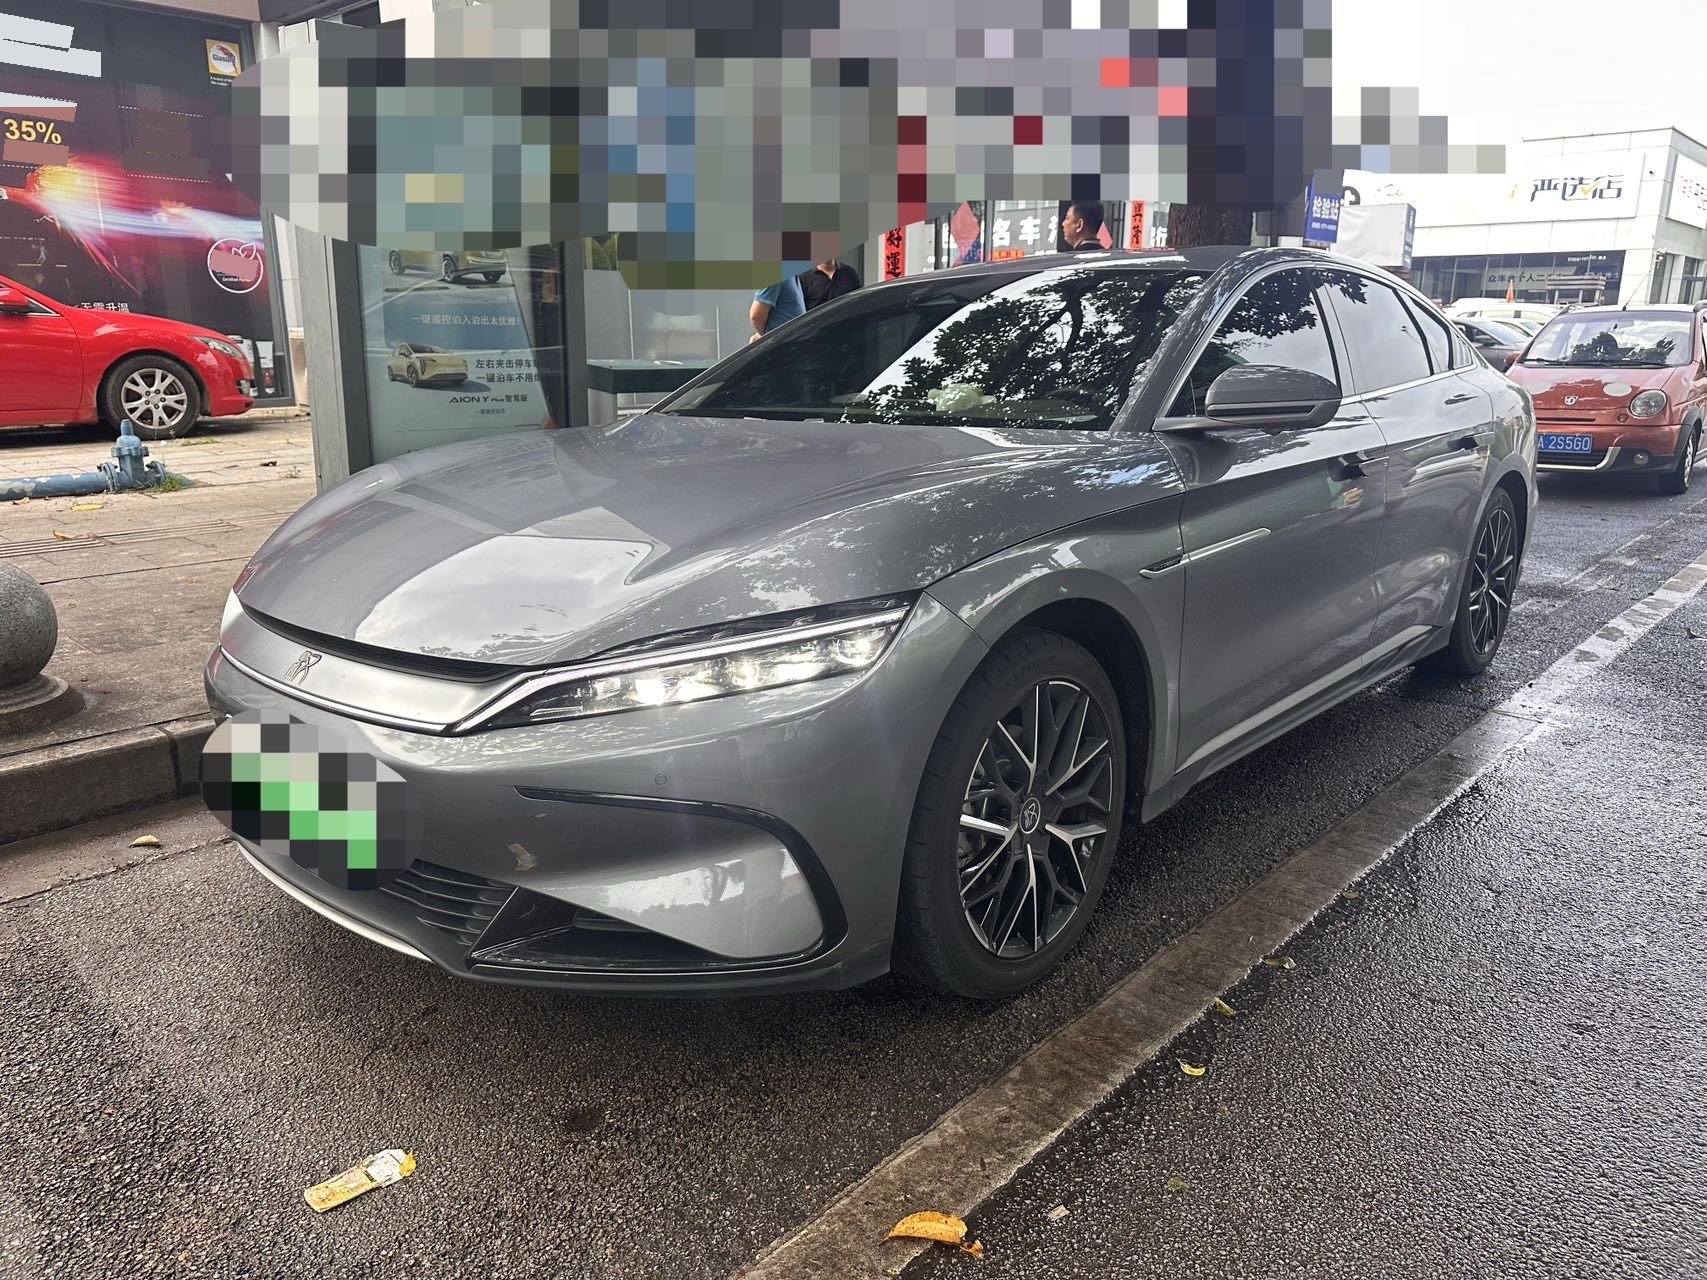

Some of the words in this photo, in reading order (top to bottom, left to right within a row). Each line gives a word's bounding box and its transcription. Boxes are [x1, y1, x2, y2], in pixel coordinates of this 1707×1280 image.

[3, 118, 62, 144] 35%
[1530, 175, 1624, 202] 严选店
